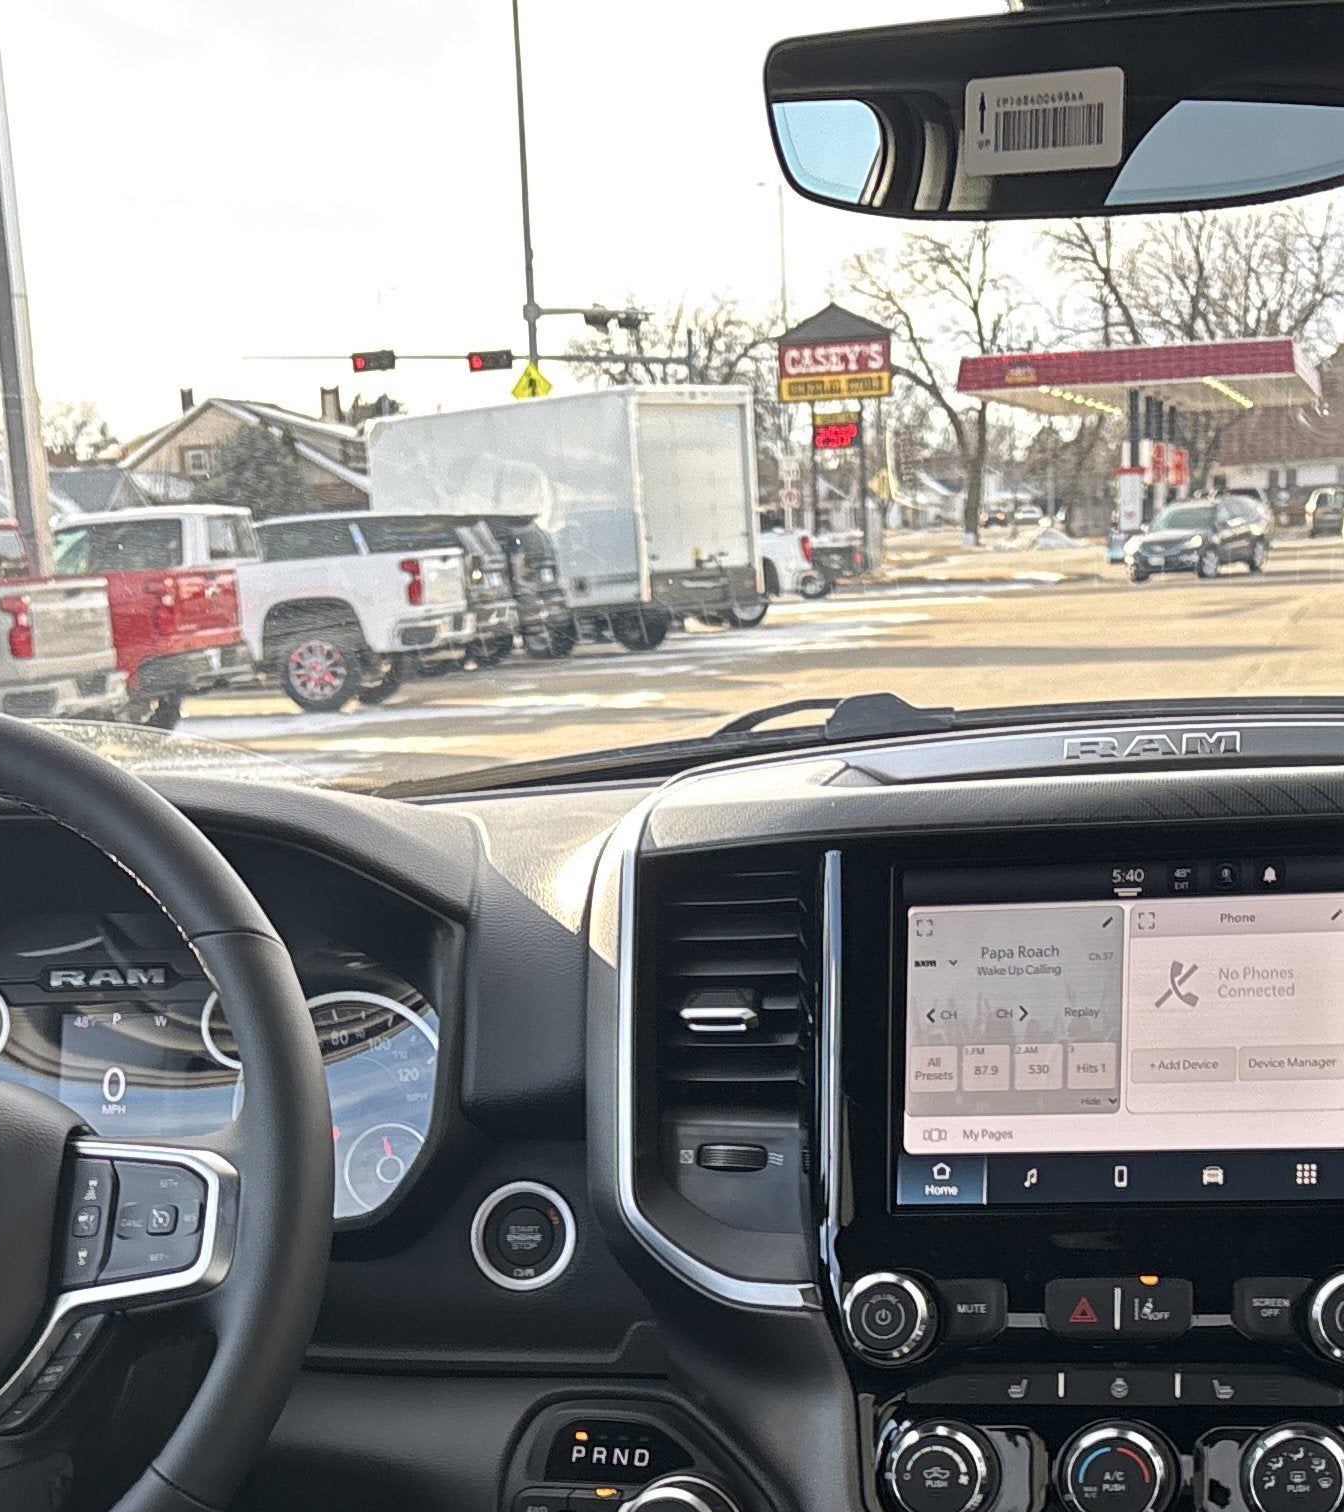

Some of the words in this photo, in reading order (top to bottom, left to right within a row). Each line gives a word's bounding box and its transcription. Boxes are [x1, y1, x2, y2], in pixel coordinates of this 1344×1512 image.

[784, 342, 885, 375] CASEY'S
[1063, 731, 1241, 760] RAM
[1112, 868, 1145, 884] 5:40
[1220, 912, 1256, 923] Phone
[981, 946, 1014, 961] Papa
[1017, 945, 1060, 959] Roach
[977, 966, 1006, 976] Wake
[1008, 966, 1024, 976] Up
[1025, 965, 1061, 977] Calling
[1218, 967, 1239, 980] No
[1243, 966, 1294, 980] Phones
[50, 968, 166, 987] RAM
[1217, 984, 1296, 998] Connected
[940, 1009, 957, 1020] CH
[996, 1009, 1013, 1019] CH
[1064, 1007, 1100, 1018] Replay
[112, 1013, 122, 1025] P
[927, 1058, 941, 1067] All
[1157, 1060, 1180, 1070] Add
[1182, 1059, 1219, 1069] Device
[1248, 1058, 1285, 1069] Device
[1287, 1057, 1336, 1069] Manager
[974, 1065, 999, 1075] 87.9
[1028, 1065, 1050, 1075] 530
[1076, 1064, 1099, 1073] Hits
[915, 1071, 954, 1080] Presets
[102, 1066, 126, 1102] 0
[962, 1129, 979, 1141] My
[981, 1129, 1014, 1141] Pages
[924, 1185, 958, 1196] Home
[1252, 1298, 1291, 1307] SCREEN
[957, 1303, 987, 1314] MUTE
[1260, 1308, 1280, 1317] OFF
[1102, 1471, 1125, 1482] A/C
[925, 1480, 949, 1488] PUSH
[1102, 1483, 1126, 1492] PUSH
[1286, 1484, 1310, 1493] PUSH
